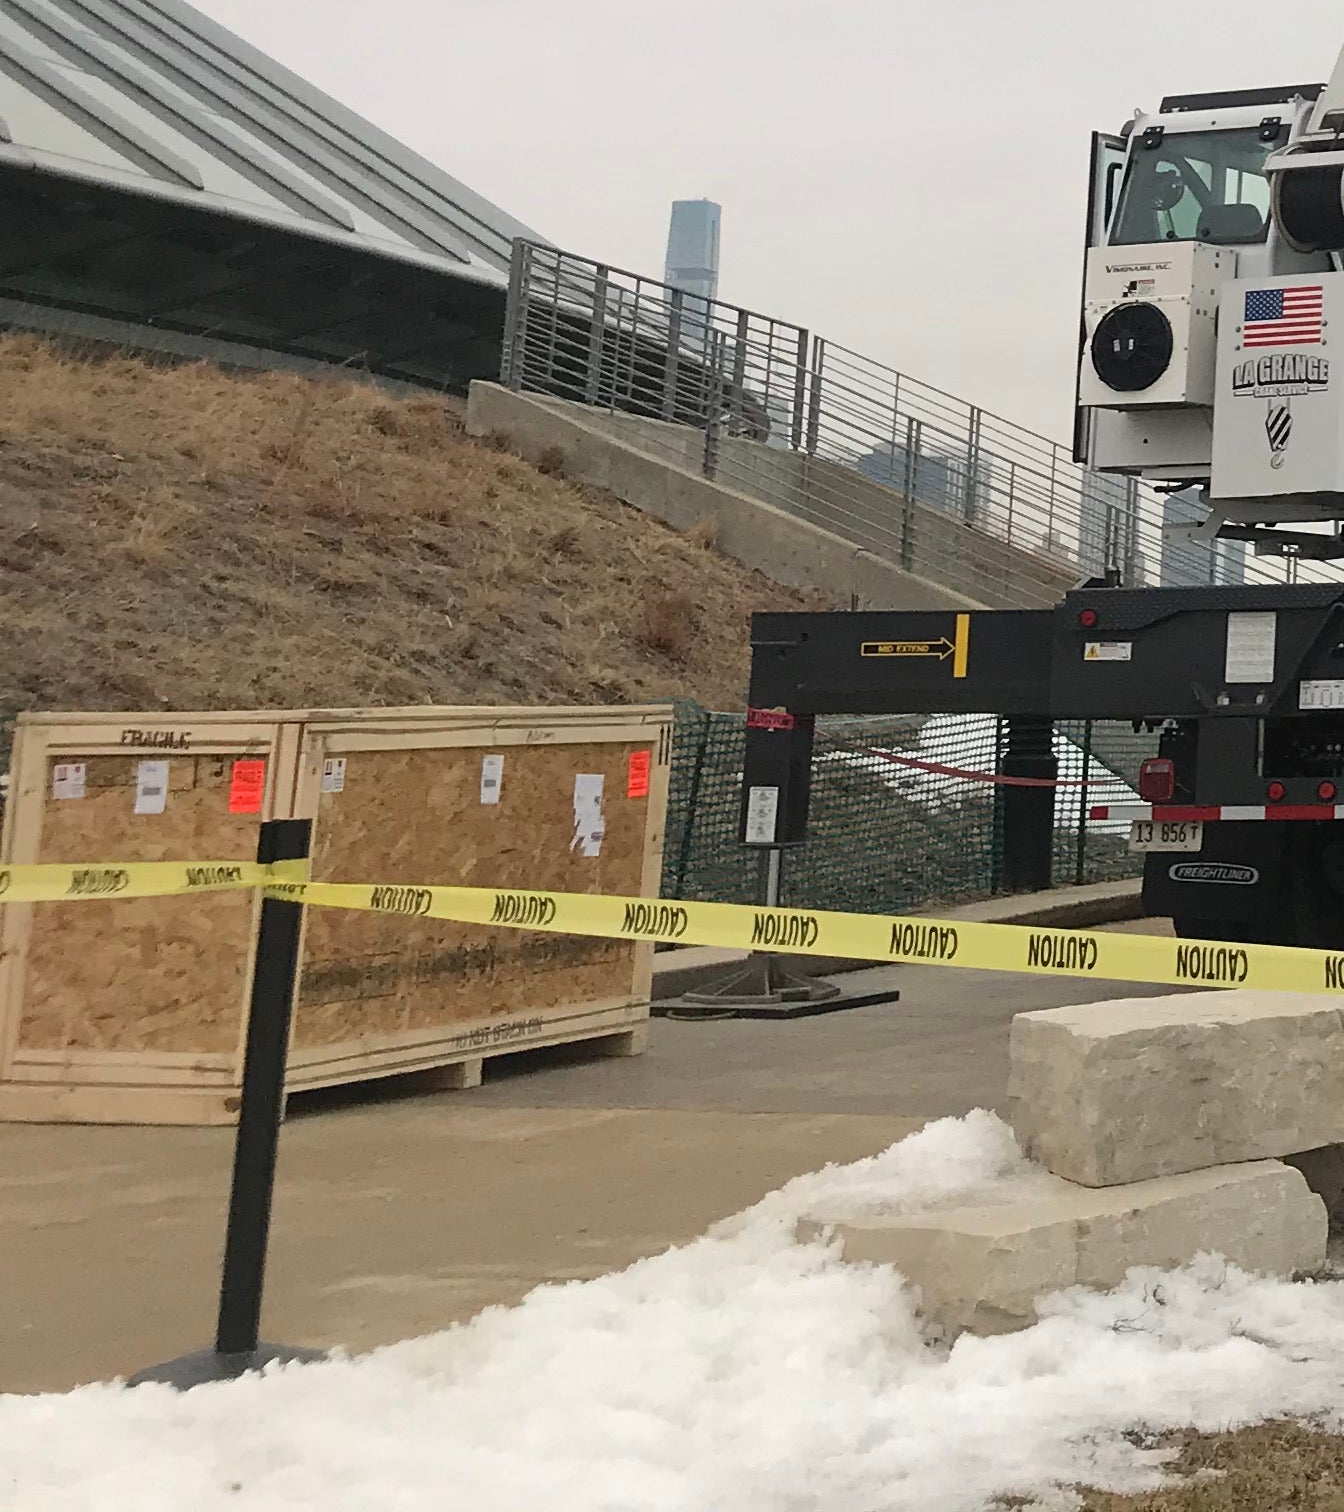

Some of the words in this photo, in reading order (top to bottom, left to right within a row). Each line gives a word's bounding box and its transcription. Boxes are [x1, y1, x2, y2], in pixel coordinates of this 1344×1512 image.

[1232, 359, 1256, 390] LA
[1257, 353, 1329, 386] GRANGE
[120, 729, 192, 749] FRAGILE
[1135, 823, 1154, 843] 13
[1161, 823, 1187, 843] 856
[1177, 866, 1251, 880] FREIGHTLINER
[370, 887, 432, 915] CAUTION
[489, 894, 556, 926] CAUTION
[621, 902, 688, 938] CAUTION
[750, 913, 818, 947] CAUTION
[889, 923, 958, 960] CAUTION
[1027, 934, 1097, 970] CAUTION
[1176, 945, 1248, 982] CAUTION
